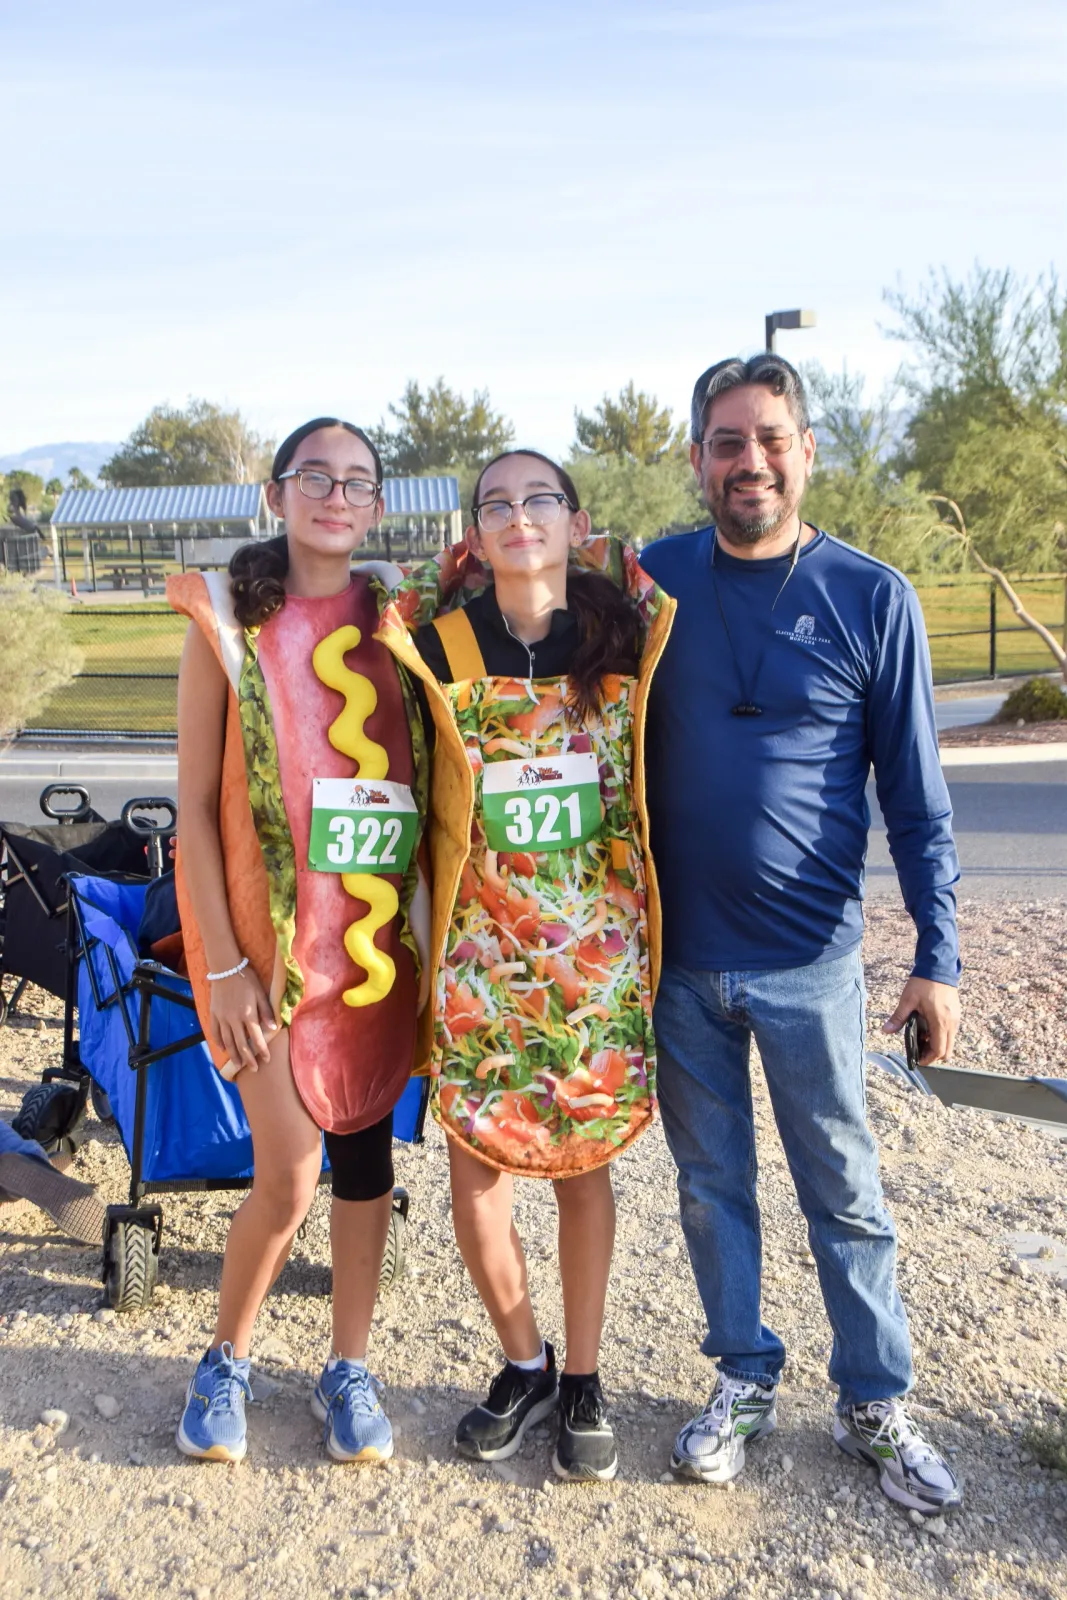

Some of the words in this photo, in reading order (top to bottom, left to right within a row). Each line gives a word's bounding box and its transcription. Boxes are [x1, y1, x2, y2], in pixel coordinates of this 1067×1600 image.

[789, 636, 815, 645] MONTANA
[795, 633, 817, 641] NATIONAL
[504, 791, 582, 845] 321
[326, 815, 403, 865] 322
